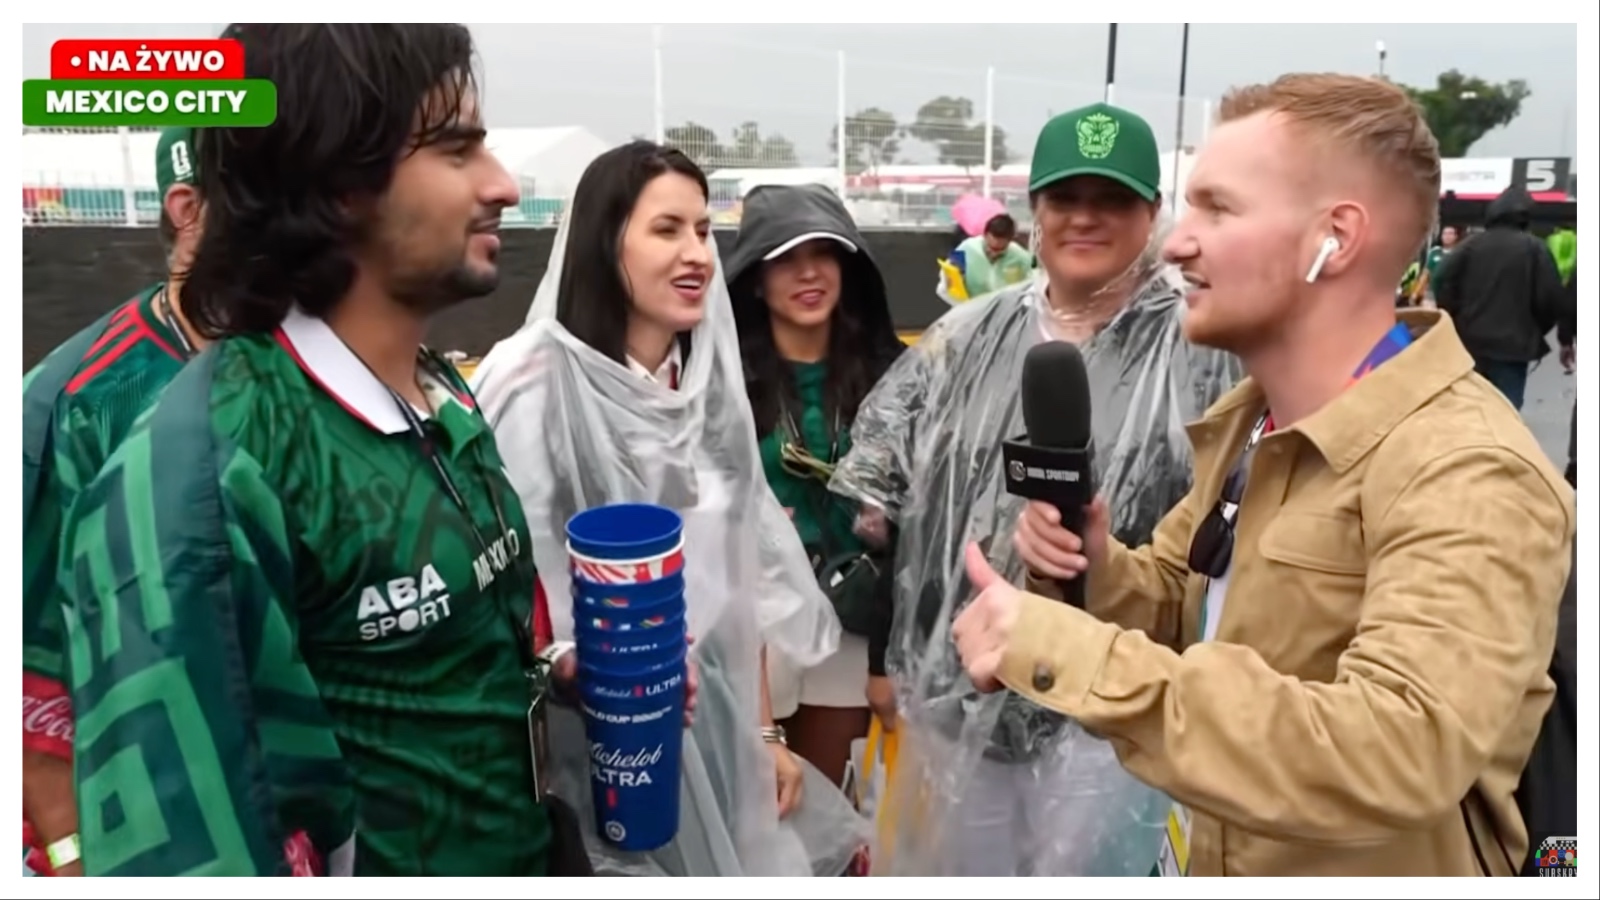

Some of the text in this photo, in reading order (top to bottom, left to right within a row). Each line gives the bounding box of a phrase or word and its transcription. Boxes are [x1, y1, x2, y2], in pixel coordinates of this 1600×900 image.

[1526, 159, 1556, 192] 5
[472, 527, 520, 592] MXIO
[356, 563, 448, 620] ABA
[358, 593, 451, 641] SPORT
[593, 766, 653, 787] LTRA
